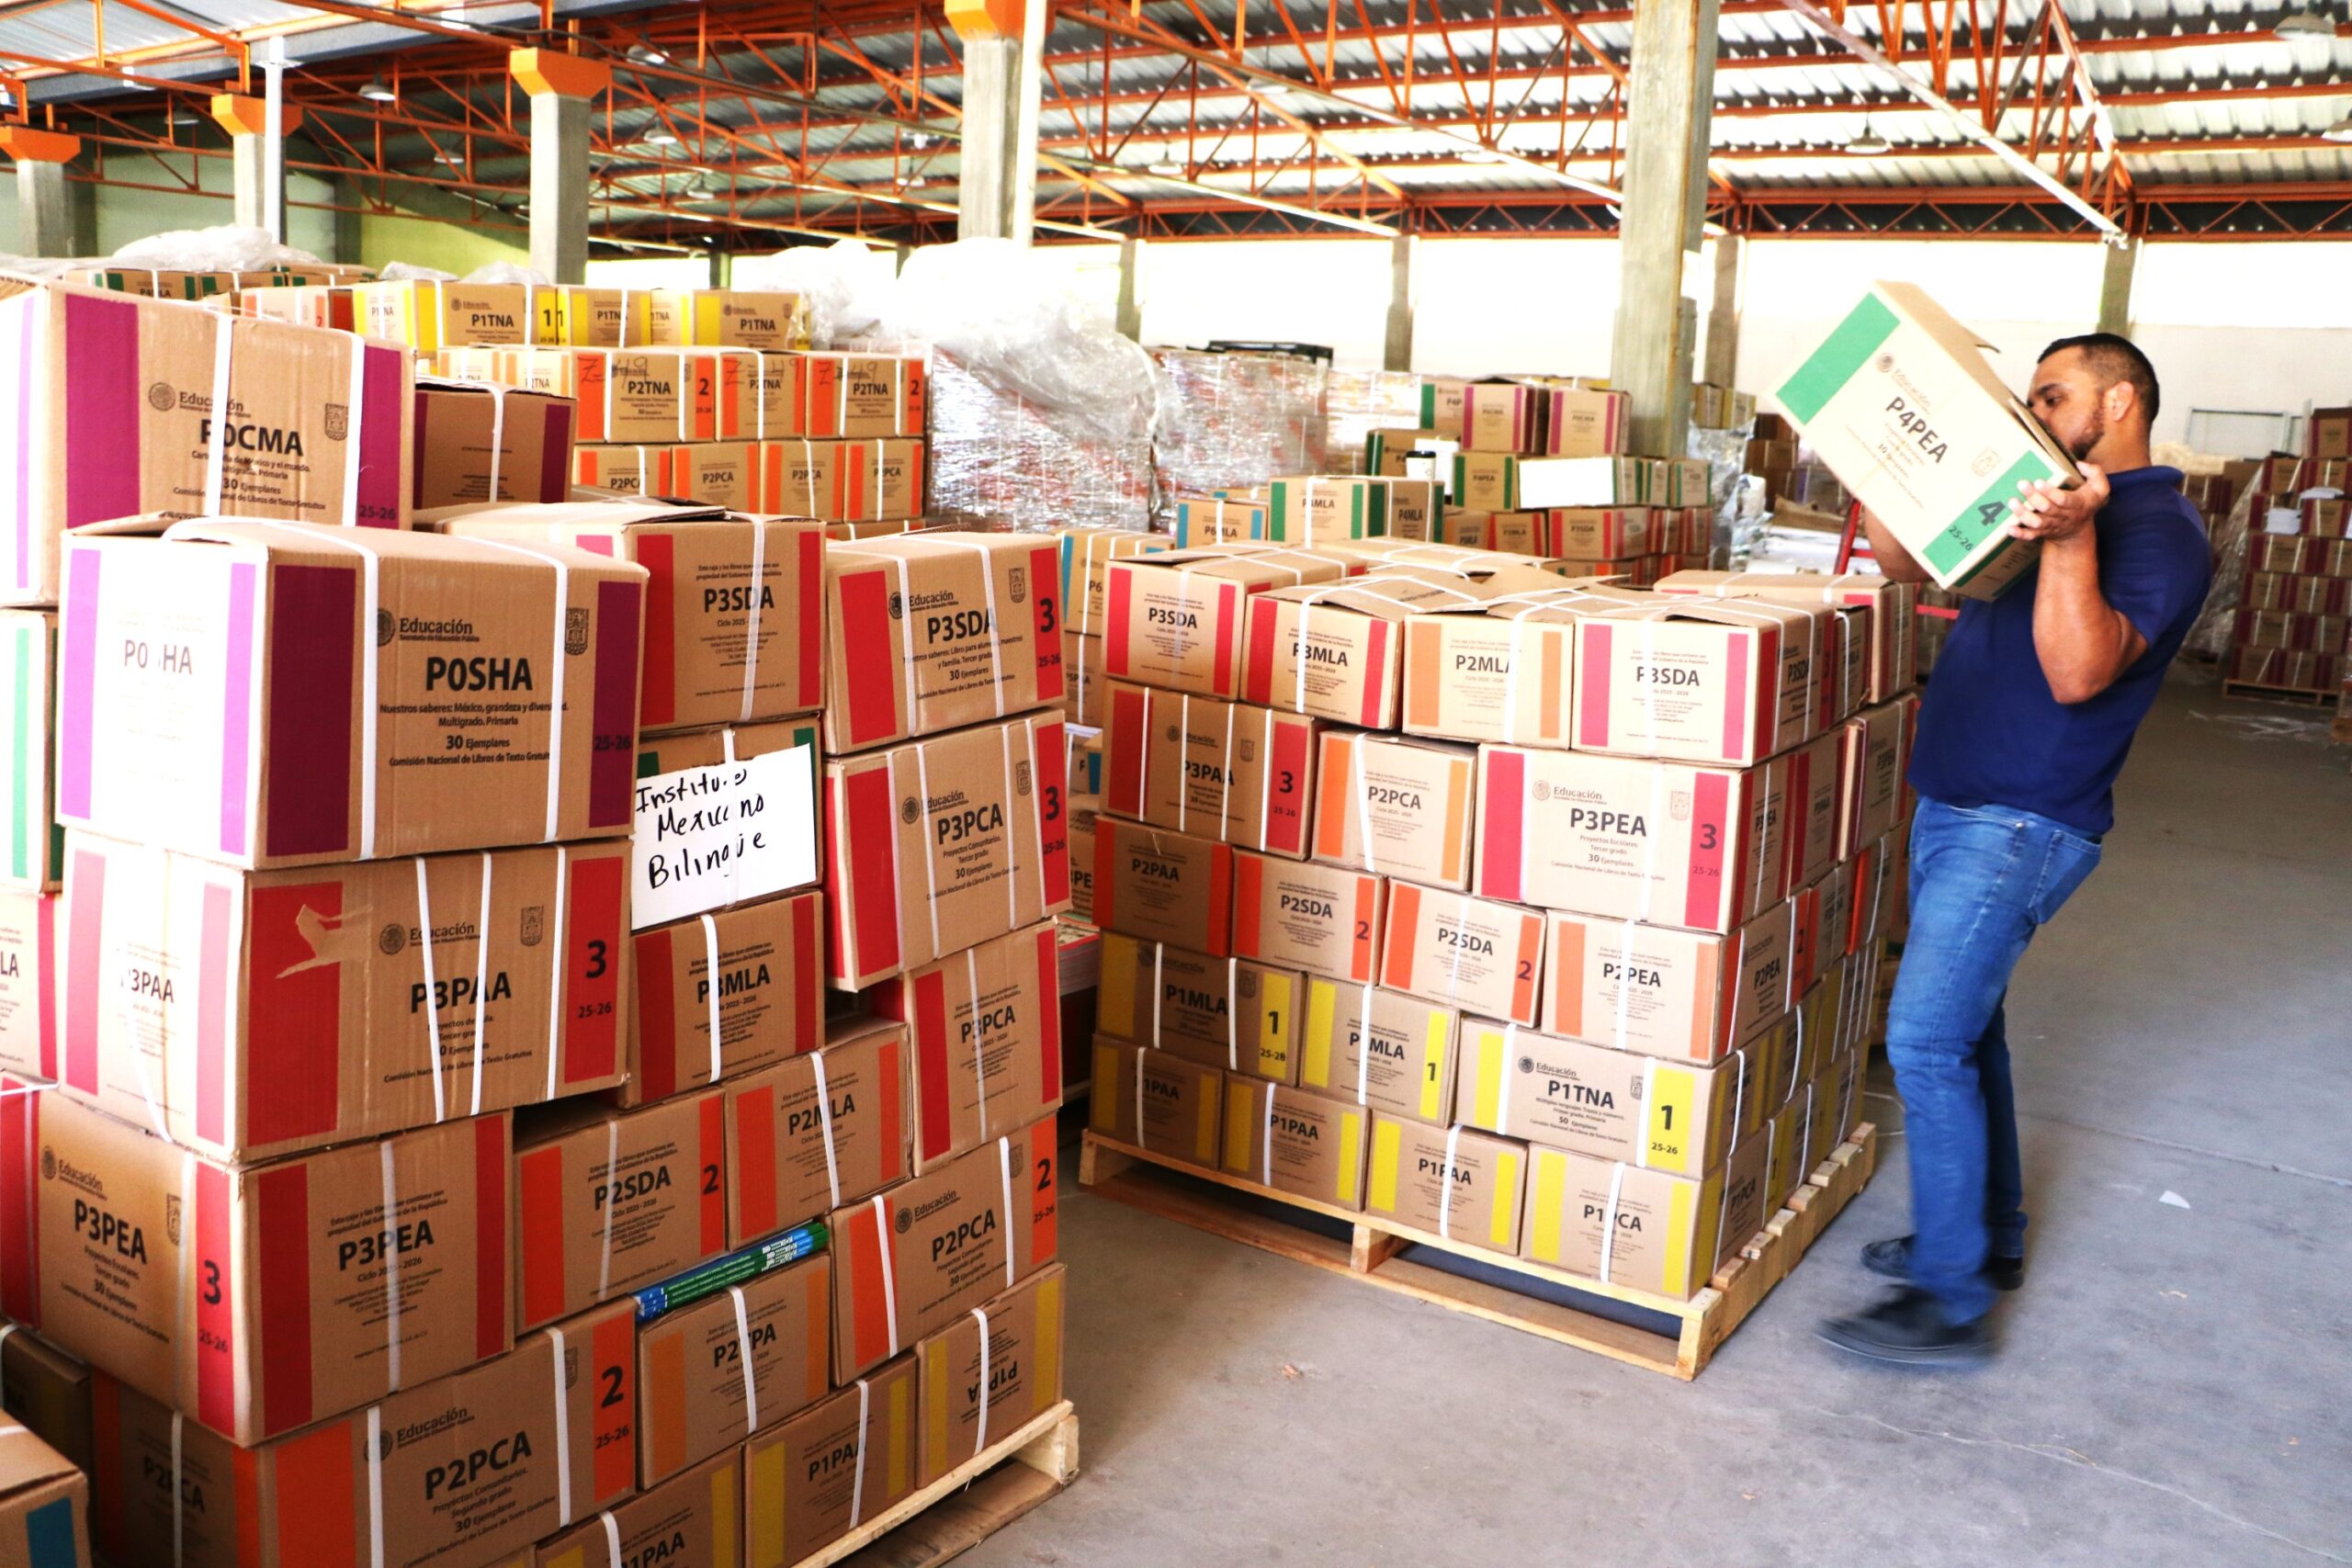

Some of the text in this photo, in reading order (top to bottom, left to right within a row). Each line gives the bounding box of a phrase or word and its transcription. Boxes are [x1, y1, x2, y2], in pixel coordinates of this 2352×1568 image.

[140, 288, 171, 299] P4LA
[371, 307, 394, 317] P1NA
[471, 313, 514, 327] P1TNA
[543, 309, 551, 327] 1
[597, 310, 628, 321] P1TN
[740, 318, 775, 332] P1TNA
[628, 381, 672, 395] P2TNA
[698, 378, 709, 396] 2
[853, 382, 888, 395] P2TNA
[910, 378, 920, 396] 2
[1885, 396, 1950, 465] P4PEA
[222, 478, 239, 490] 30
[702, 471, 734, 484] P2PCA
[874, 467, 901, 479] PPCA
[1977, 501, 2006, 526] 4
[1948, 525, 1973, 552] 25-26
[704, 585, 775, 614] P3SDA
[909, 590, 954, 606] Educación
[399, 617, 473, 635] Educación
[1039, 598, 1055, 633] 3
[1148, 606, 1198, 629] P3SDA
[1038, 653, 1061, 669] 25-26
[949, 669, 960, 682] 30
[379, 702, 528, 715] Nuestros saberes: México, grandeza y
[438, 716, 518, 728] Multigrado. Primaria
[446, 735, 510, 750] 30 Ejemplares
[594, 736, 631, 750] 25-26
[390, 751, 526, 766] Comisión Nacional de Libros de Texto
[1278, 771, 1295, 794] 3
[1554, 785, 1602, 801] Educación
[1045, 785, 1060, 821] 3
[1367, 785, 1421, 810] P2PCA
[937, 803, 1004, 845] P3PCA
[1570, 807, 1647, 837] P3PEA
[1043, 839, 1066, 855] 25-26
[1579, 834, 1609, 844] Proyectos
[1699, 823, 1717, 850] 3
[1588, 853, 1600, 863] 30
[1590, 844, 1627, 855] Tercer grado
[956, 867, 966, 880] 30
[1131, 858, 1180, 883] P2PAA
[1691, 864, 1720, 877] 25-26
[1280, 894, 1333, 919] P2SDA
[1356, 920, 1370, 941] 2
[1437, 928, 1494, 956] P2SDA
[584, 940, 606, 979] 3
[1517, 960, 1532, 981] 2
[119, 968, 174, 1003] 3PAA
[578, 1001, 612, 1019] 25-26
[1166, 984, 1228, 1015] P1MLA
[1268, 1010, 1279, 1035] 1
[1349, 1032, 1406, 1060] PMLA
[1427, 1062, 1437, 1082] 1
[1536, 1062, 1577, 1077] Educación
[1548, 1079, 1615, 1110] P1TNA
[1270, 1113, 1319, 1140] P1PAA
[1558, 1116, 1568, 1125] 50
[1660, 1104, 1673, 1131] 1
[1651, 1141, 1679, 1155] 25-26
[58, 1158, 103, 1192] Educación
[703, 1163, 719, 1195] 2
[1036, 1156, 1052, 1191] 2
[594, 1165, 672, 1212] P2SDA
[914, 1190, 956, 1218] Educación
[1033, 1205, 1055, 1224] 25-26
[74, 1198, 148, 1266] P3PEA
[932, 1208, 997, 1263] P2PCA
[338, 1219, 435, 1271] P3PEA
[204, 1258, 221, 1305] 3
[713, 1322, 777, 1369] P2PA
[601, 1365, 625, 1409] 2
[967, 1360, 1018, 1404] P1PA
[396, 1406, 468, 1443] Educación
[595, 1425, 630, 1450] 25-26
[425, 1430, 533, 1501] P2PCA
[432, 1491, 474, 1515] Proyectos
[455, 1517, 471, 1533] 30
